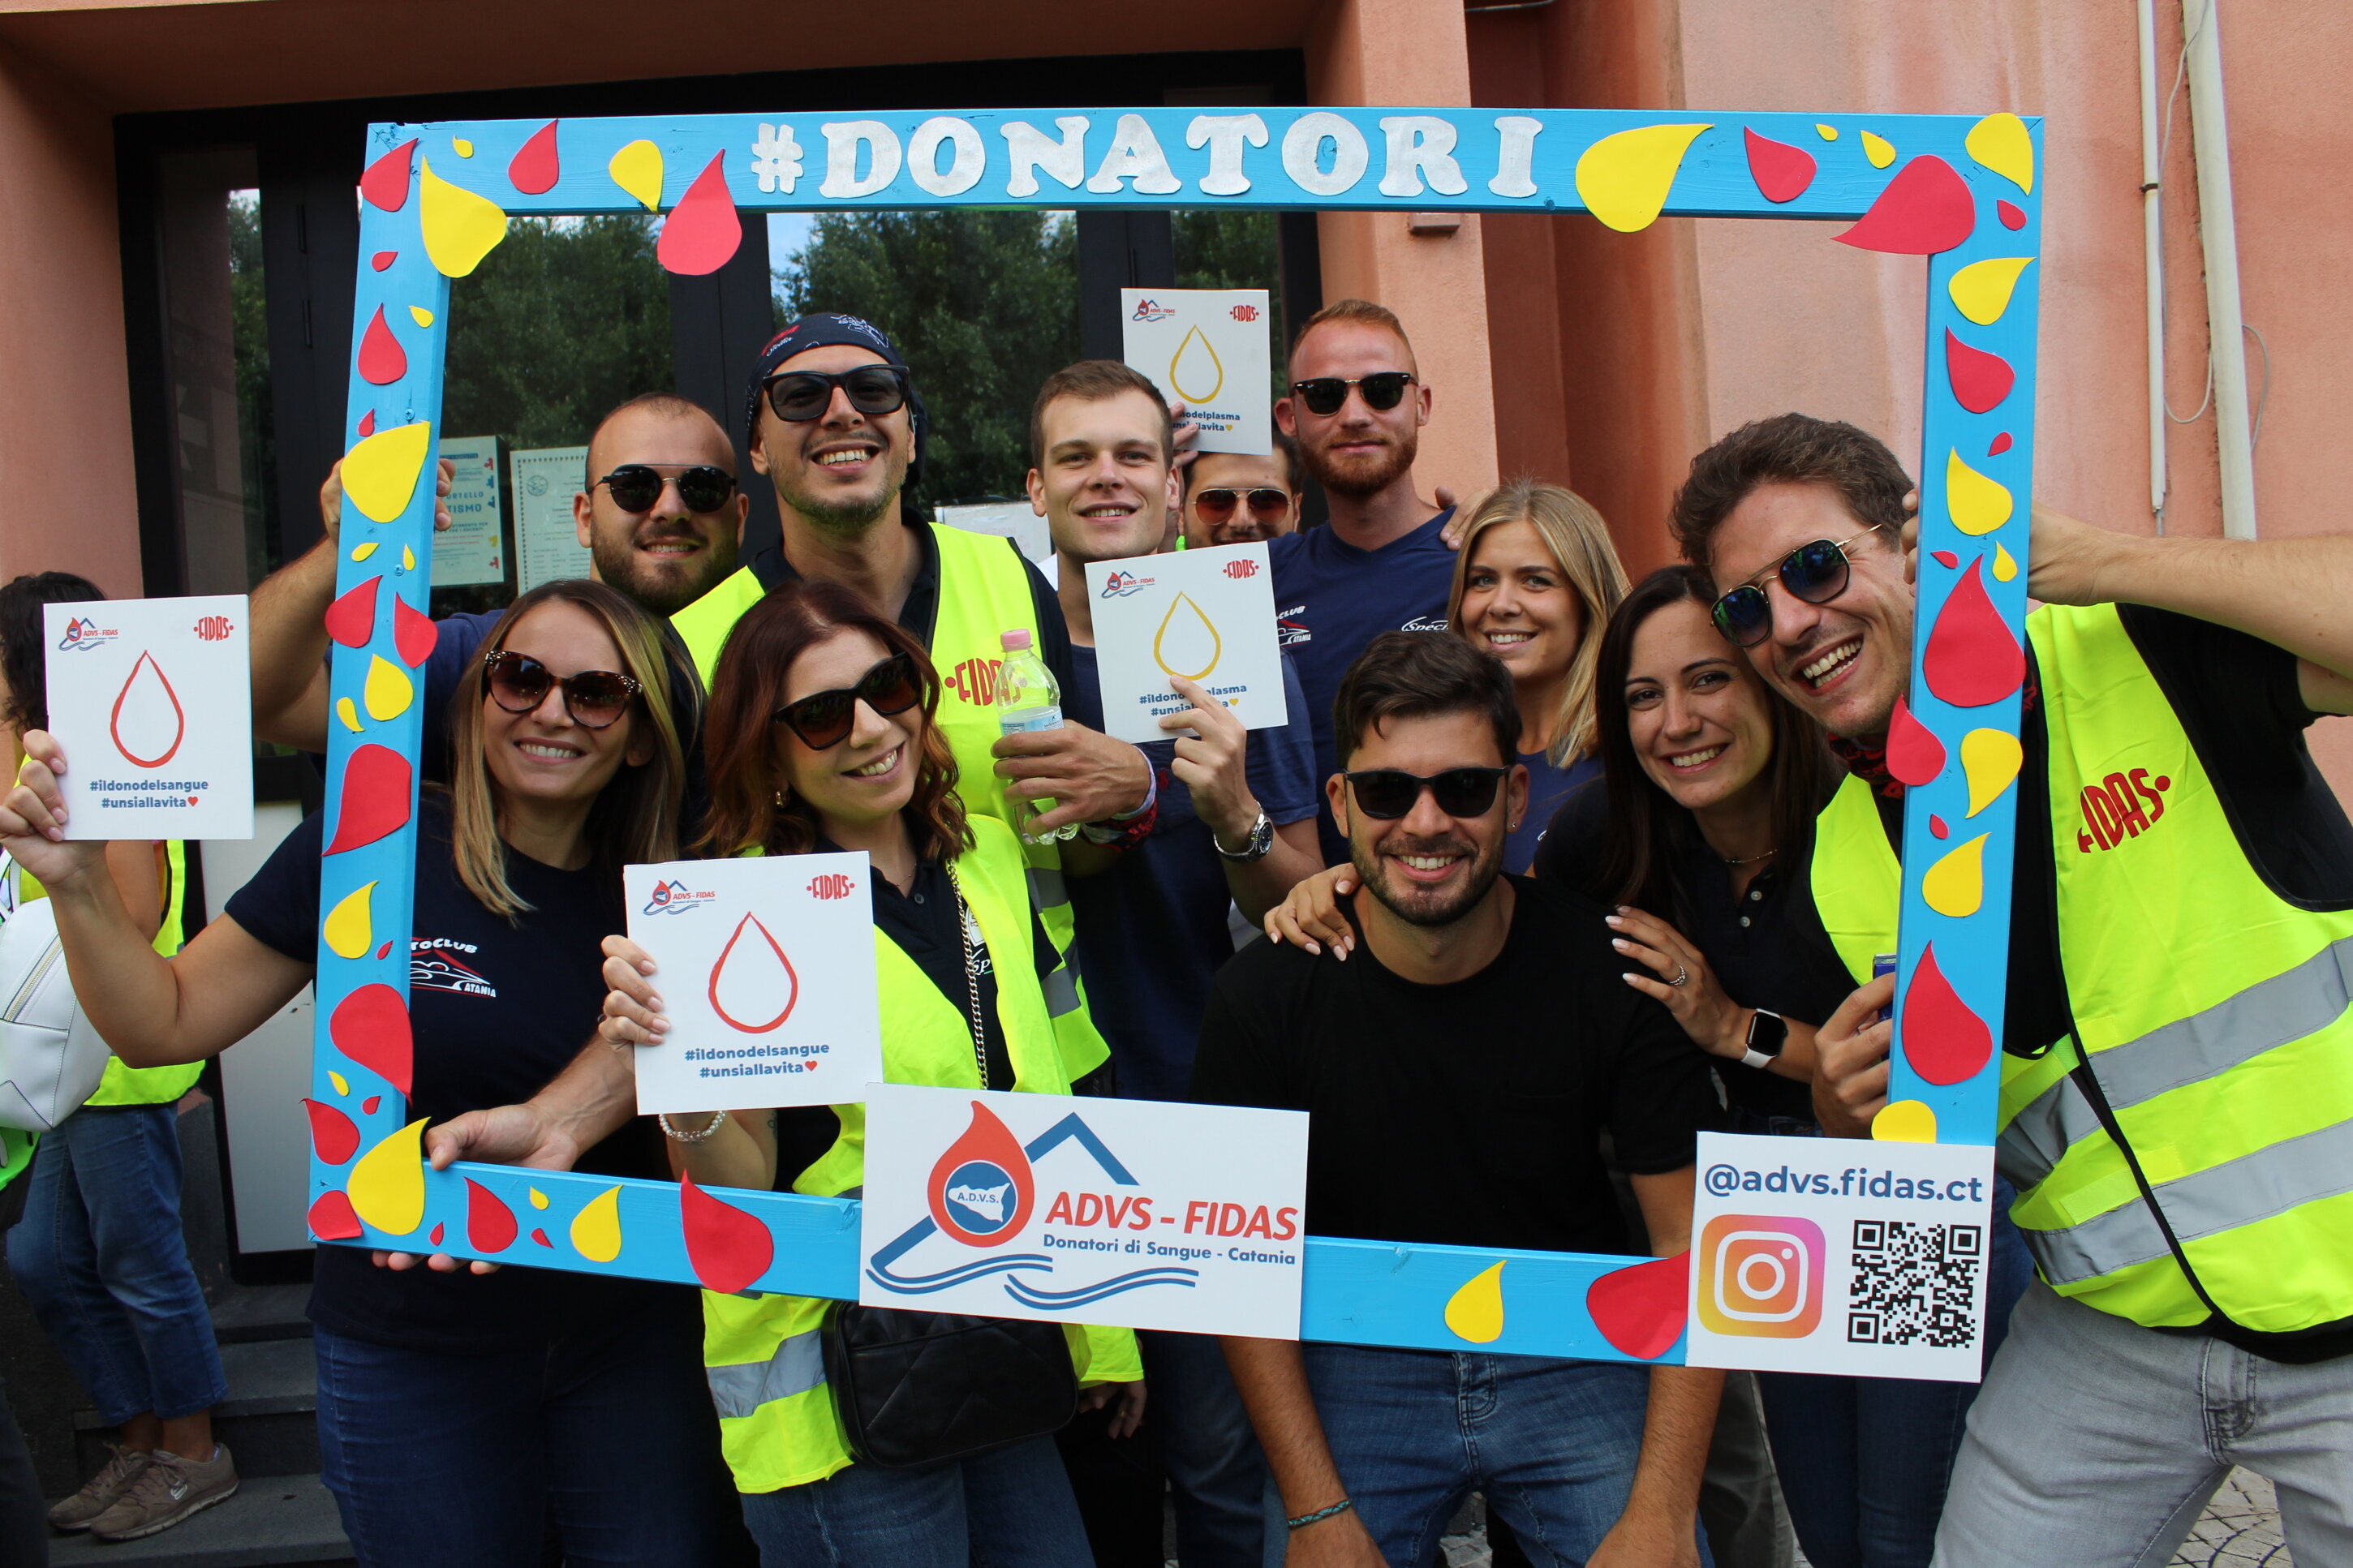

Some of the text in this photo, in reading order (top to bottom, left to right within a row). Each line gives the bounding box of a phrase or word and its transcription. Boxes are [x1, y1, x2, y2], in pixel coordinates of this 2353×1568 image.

[751, 111, 1543, 200] #DONATORI
[1232, 305, 1256, 322] FIDAS
[1179, 410, 1241, 421] nodelplasma
[448, 504, 481, 513] TISMO
[1226, 559, 1256, 579] FIDAS
[1276, 605, 1306, 621] CLUB
[198, 616, 230, 641] FIDAS
[89, 779, 209, 793] #ildonodelsangue
[101, 796, 187, 809] #unsiallavita
[695, 891, 716, 899] FIDAS
[812, 874, 850, 900] FIDAS
[410, 938, 478, 954] TOCLUB
[684, 1044, 830, 1061] #ildonodelsangue
[699, 1061, 804, 1078] #unsiallavita
[1704, 1163, 1984, 1203] @advs.fidas.ct
[957, 1191, 1000, 1204] A.D.V.S.
[1044, 1191, 1153, 1231] ADVS
[1183, 1200, 1299, 1242] FIDAS
[1043, 1234, 1119, 1252] Donatori
[1125, 1239, 1141, 1254] di
[1146, 1241, 1212, 1261] Sangue
[1228, 1247, 1297, 1265] Catania
